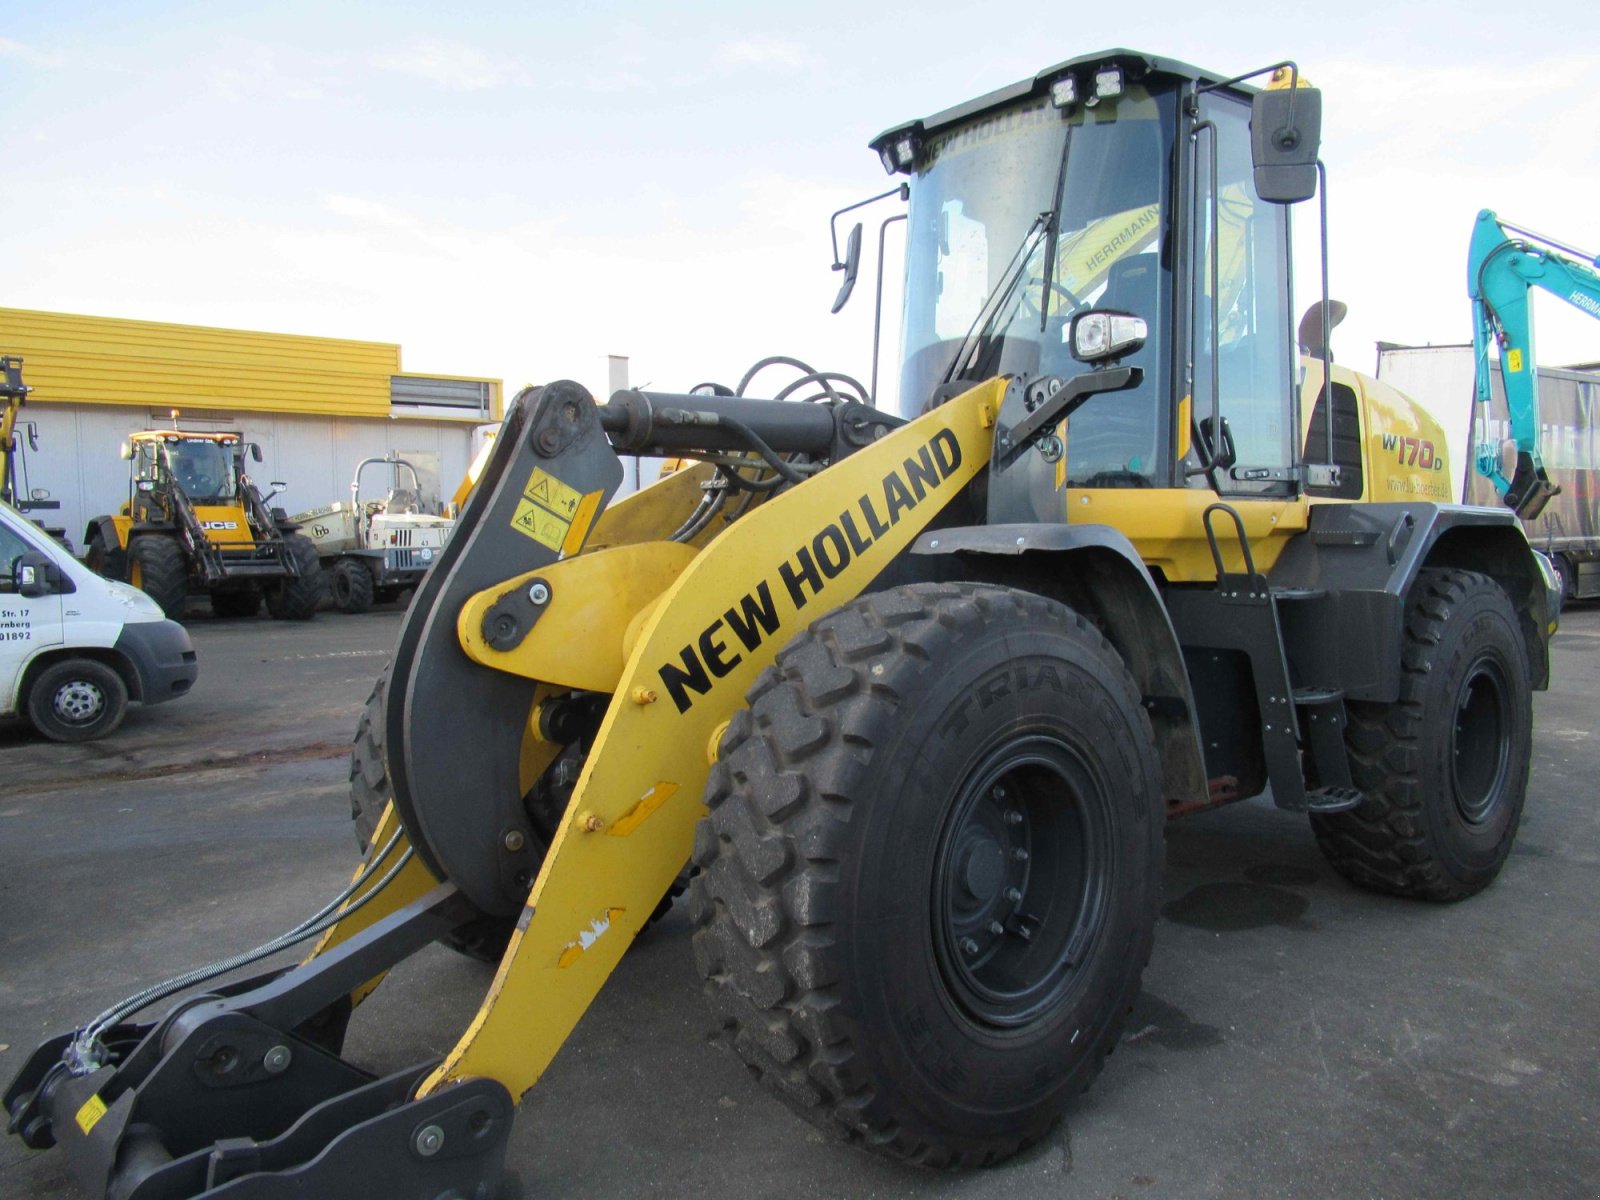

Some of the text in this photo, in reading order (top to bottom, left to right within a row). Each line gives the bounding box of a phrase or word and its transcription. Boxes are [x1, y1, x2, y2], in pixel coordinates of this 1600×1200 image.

[1085, 205, 1160, 272] HERRMANN
[201, 521, 238, 530] JCB
[658, 427, 962, 714] NEW HOLLAND
[2, 609, 30, 618] Str. 17
